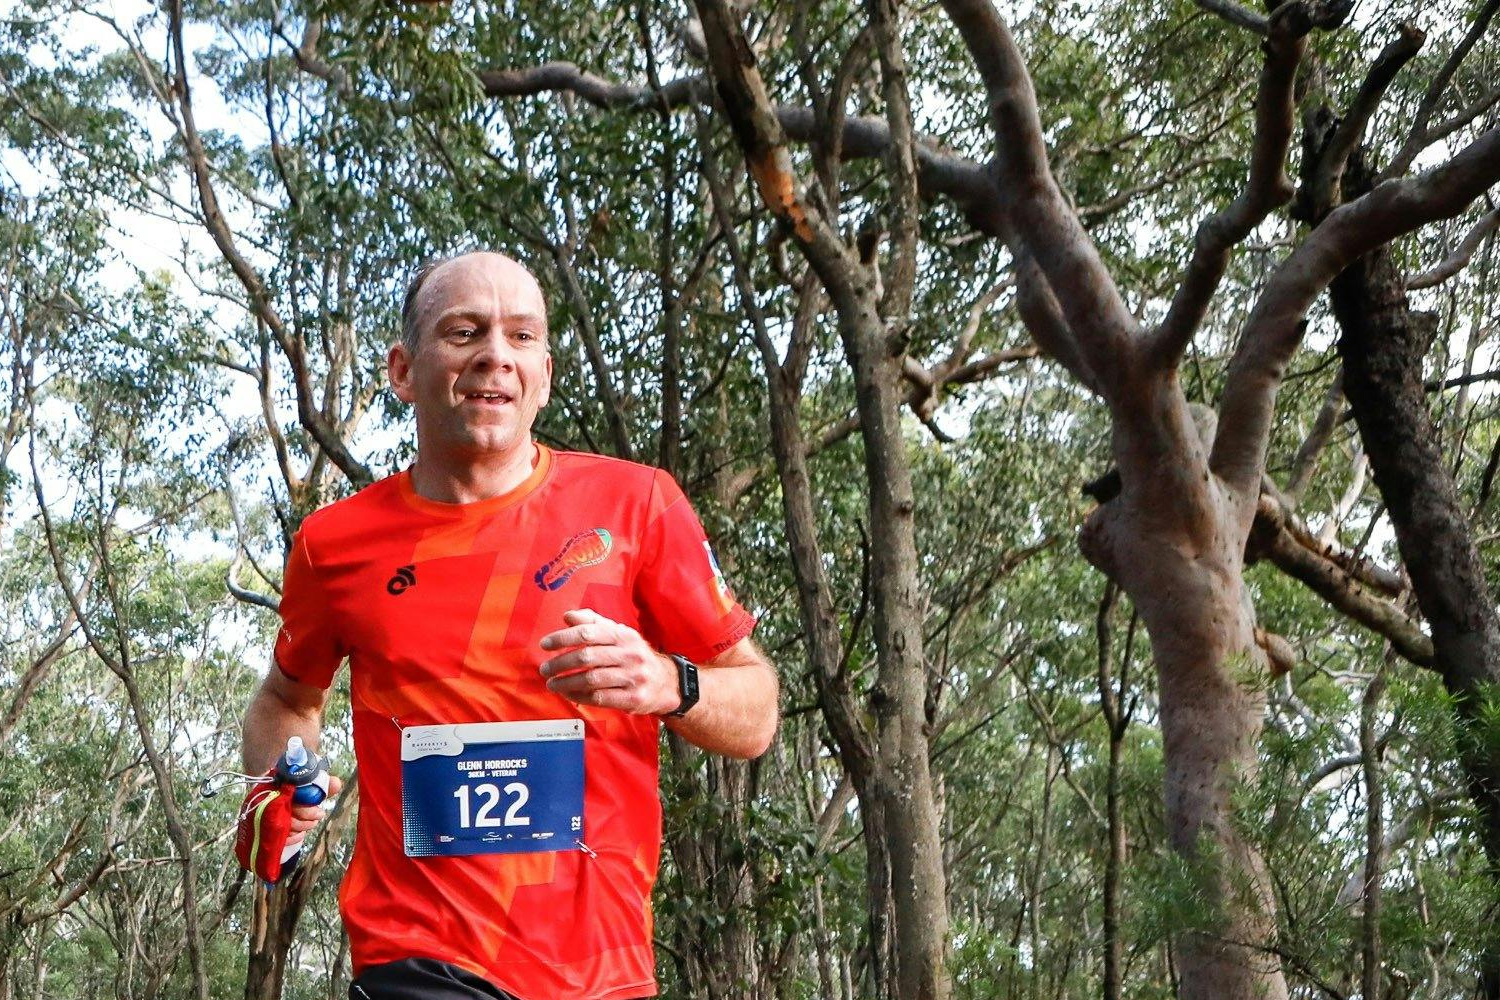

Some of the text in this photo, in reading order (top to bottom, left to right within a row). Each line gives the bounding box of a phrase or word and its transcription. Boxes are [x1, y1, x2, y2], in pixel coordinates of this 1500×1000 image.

[457, 759, 527, 771] GLENN HORROCKS
[453, 782, 530, 828] 122
[571, 816, 581, 831] 122
